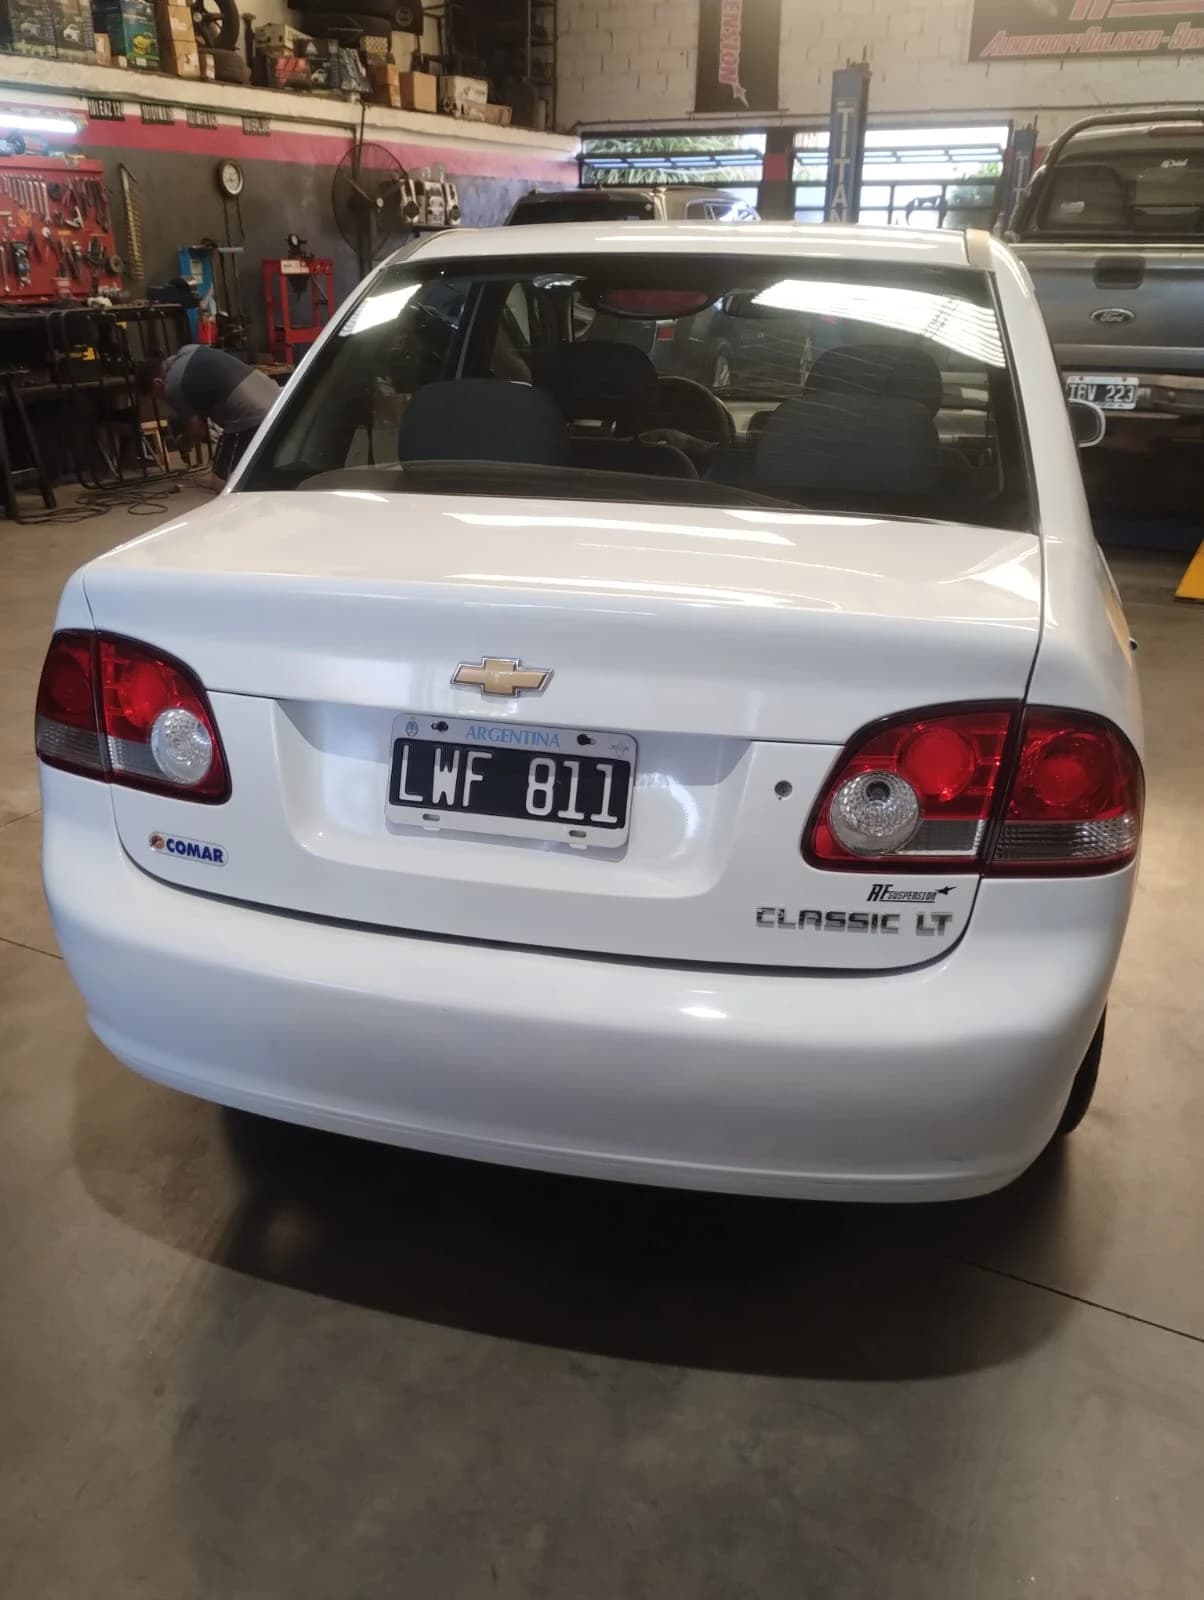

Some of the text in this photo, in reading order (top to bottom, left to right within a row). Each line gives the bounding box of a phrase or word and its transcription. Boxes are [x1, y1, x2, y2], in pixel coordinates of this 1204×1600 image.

[1104, 384, 1136, 403] 223
[465, 724, 561, 748] ARGENTINA
[399, 744, 618, 823] LWF 811
[166, 838, 224, 863] COMAR
[756, 907, 953, 937] CLASSIC LT
